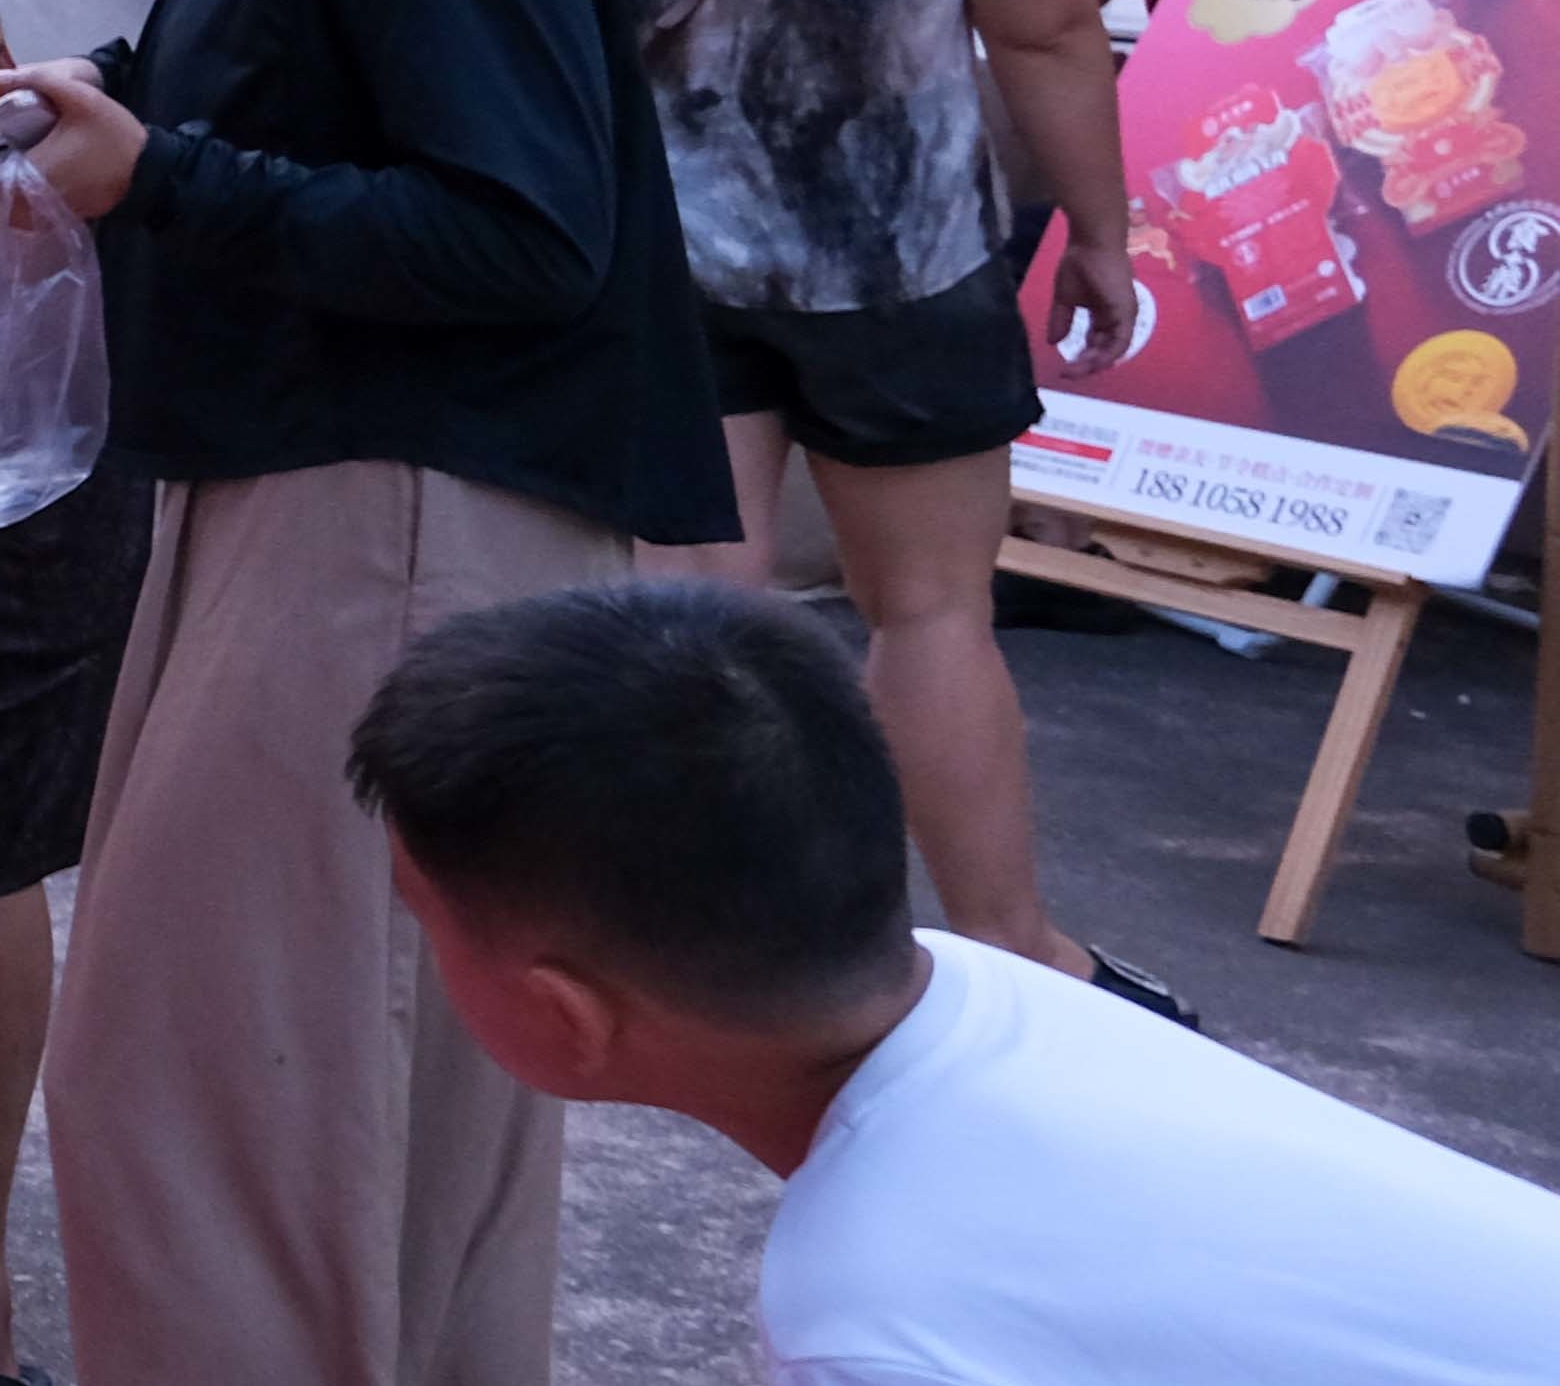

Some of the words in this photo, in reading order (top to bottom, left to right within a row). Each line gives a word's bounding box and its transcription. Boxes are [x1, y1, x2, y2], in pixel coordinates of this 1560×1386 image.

[1131, 469, 1186, 502] 188
[1188, 479, 1265, 520] 1058
[1268, 495, 1348, 536] 1988
